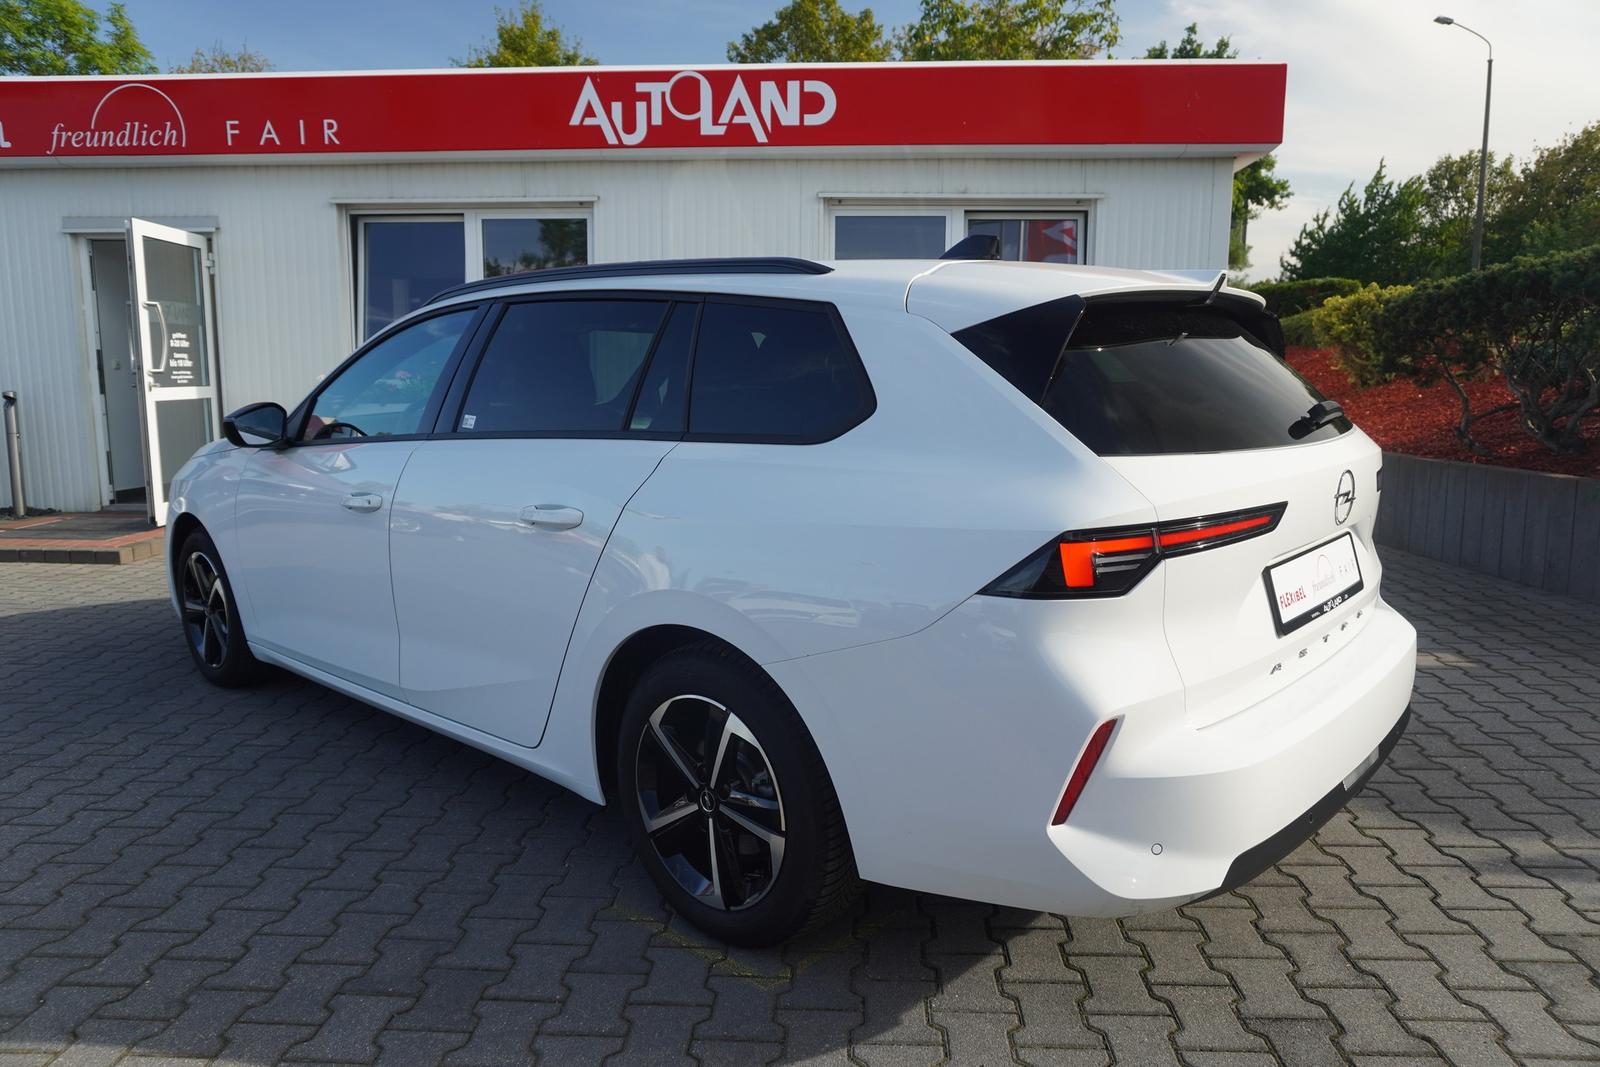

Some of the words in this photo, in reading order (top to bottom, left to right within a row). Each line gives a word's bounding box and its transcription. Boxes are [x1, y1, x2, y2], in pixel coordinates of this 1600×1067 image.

[569, 70, 837, 146] AUTOLAND
[46, 120, 179, 155] freundlich
[226, 118, 341, 146] FAIR
[1279, 585, 1307, 609] FLEXIBEL
